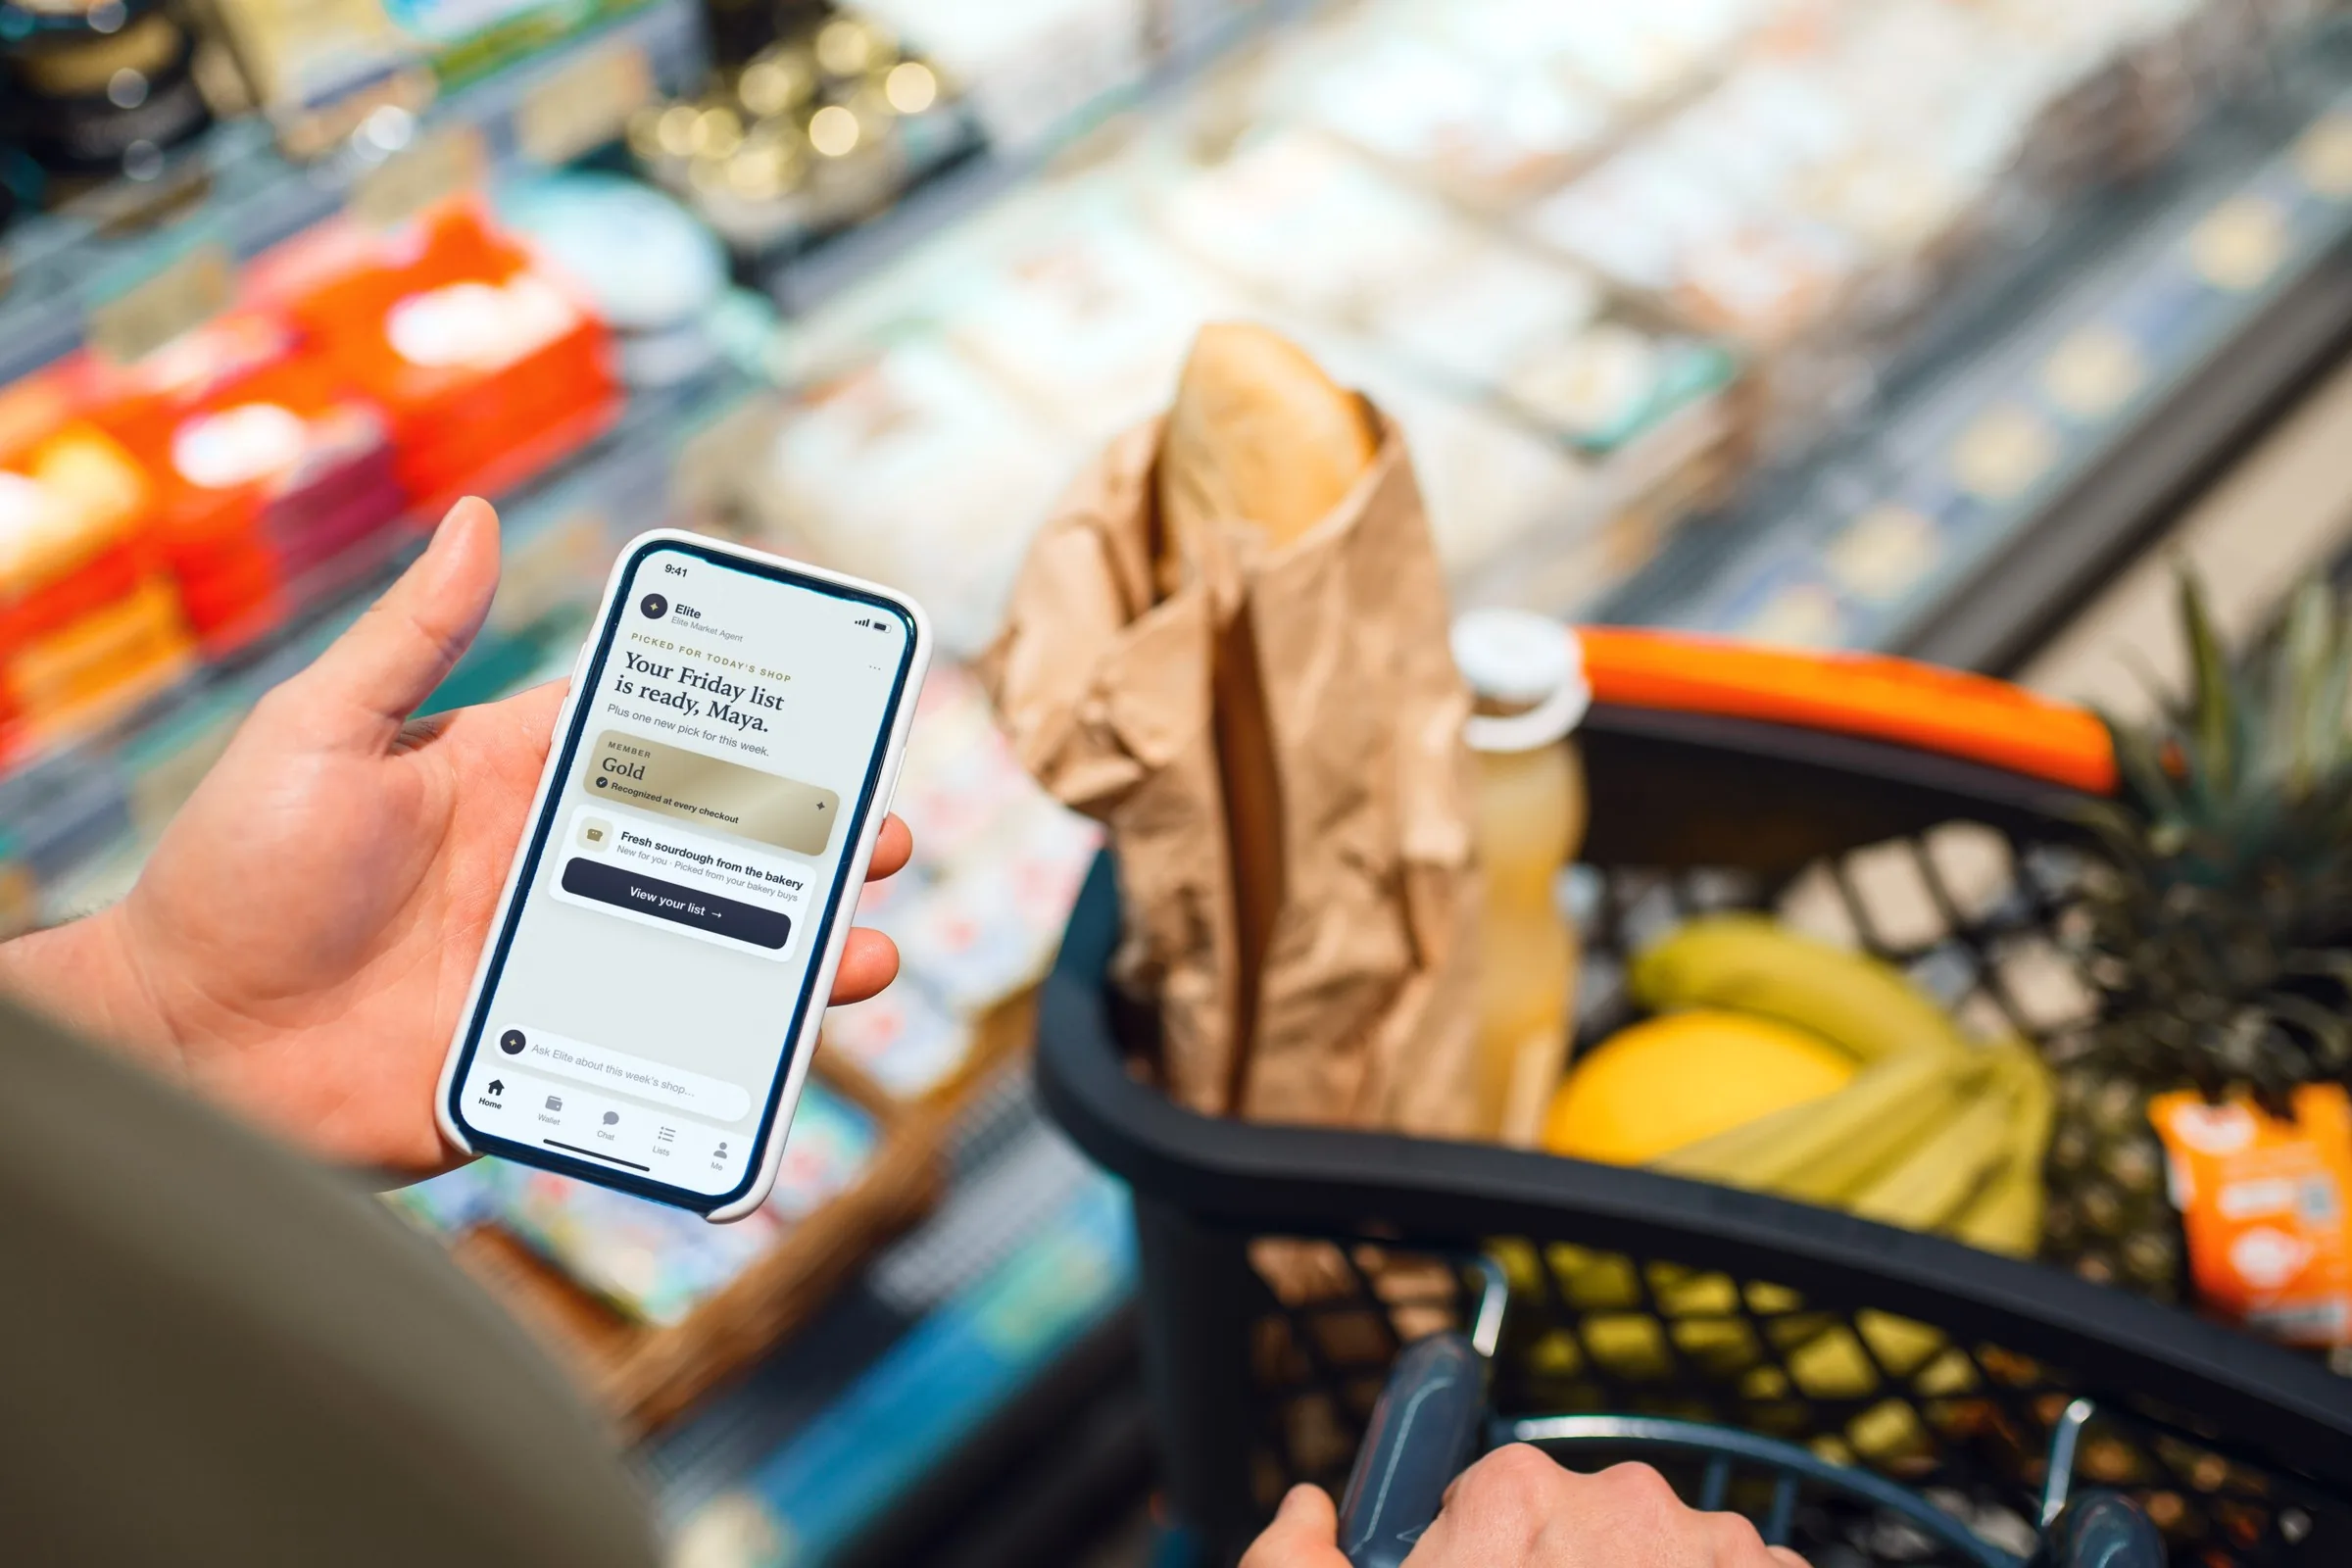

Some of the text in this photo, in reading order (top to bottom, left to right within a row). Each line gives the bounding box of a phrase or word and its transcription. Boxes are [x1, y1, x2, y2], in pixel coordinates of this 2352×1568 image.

[664, 564, 688, 578] 9:41
[674, 603, 702, 619] Elite
[670, 615, 744, 643] Elite Market Agent
[630, 632, 792, 682] PICKED FOR TODAY'S SHOP
[625, 651, 785, 711] Your Friday list
[613, 673, 768, 733] is ready, Maya.
[607, 703, 769, 757] Plus one new pick for this week.
[608, 741, 652, 759] MEMBER
[602, 757, 646, 781] Gold
[611, 781, 662, 803] Recognized
[673, 801, 698, 813] every
[698, 807, 739, 824] checkout
[615, 844, 798, 903] New for you Picked from your bakery buys
[620, 830, 804, 892] Fresh sourdough from the bakery
[630, 886, 706, 916] View your list
[530, 1044, 551, 1057] Ask
[552, 1049, 574, 1063] Elite
[574, 1056, 604, 1072] about
[605, 1064, 623, 1077] this
[477, 1097, 503, 1110] Home
[537, 1112, 561, 1126] Wallet
[596, 1129, 615, 1142] Chat
[652, 1145, 670, 1157] Lists
[710, 1160, 723, 1171] Me
